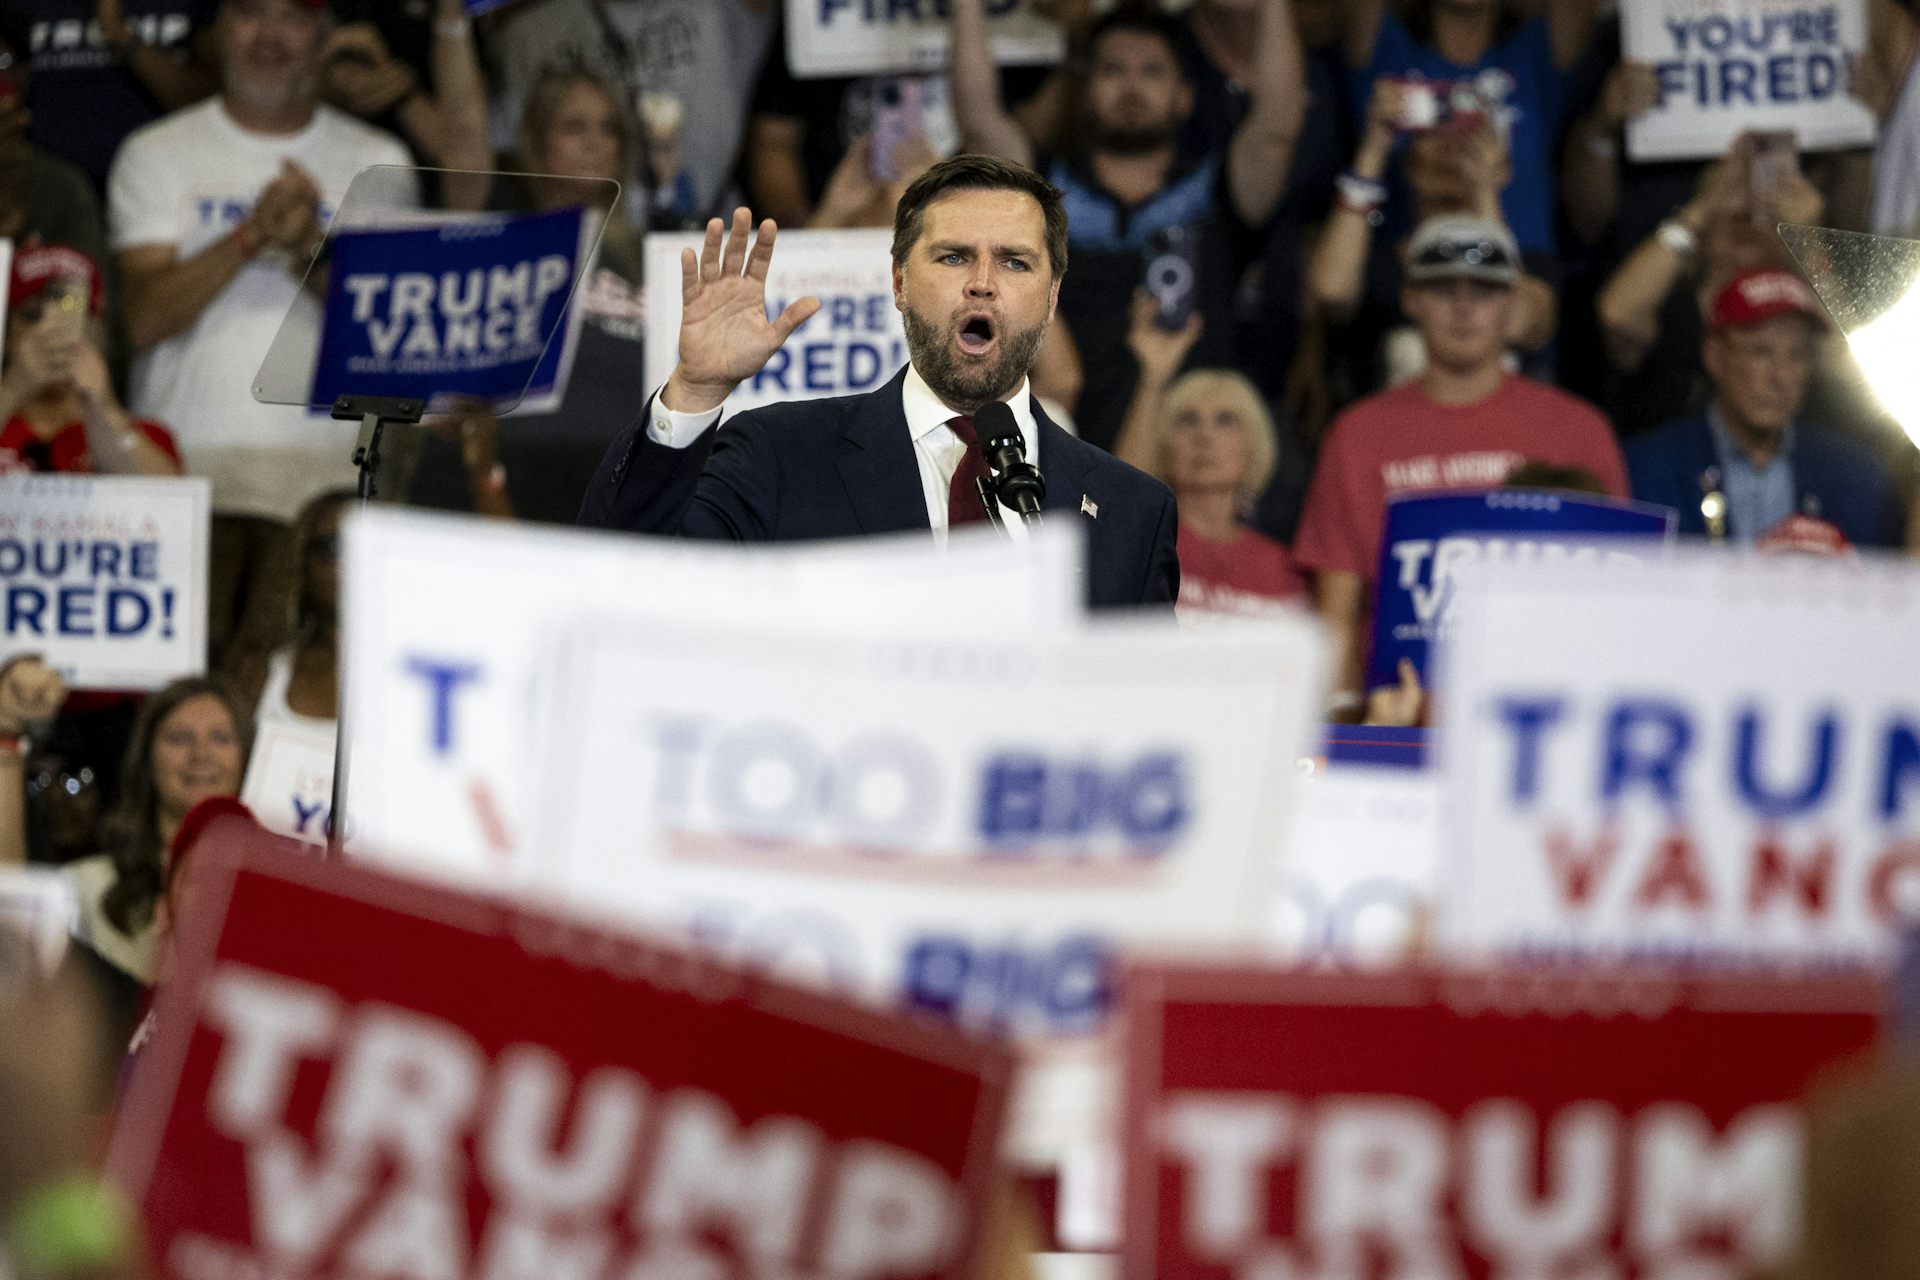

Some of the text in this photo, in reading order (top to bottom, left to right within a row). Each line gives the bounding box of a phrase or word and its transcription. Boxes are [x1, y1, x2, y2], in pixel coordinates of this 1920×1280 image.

[344, 253, 569, 322] TRUMP
[367, 308, 541, 357] VANCE
[203, 962, 968, 1278] TRUMP
[1158, 1092, 1805, 1262] TRUM
